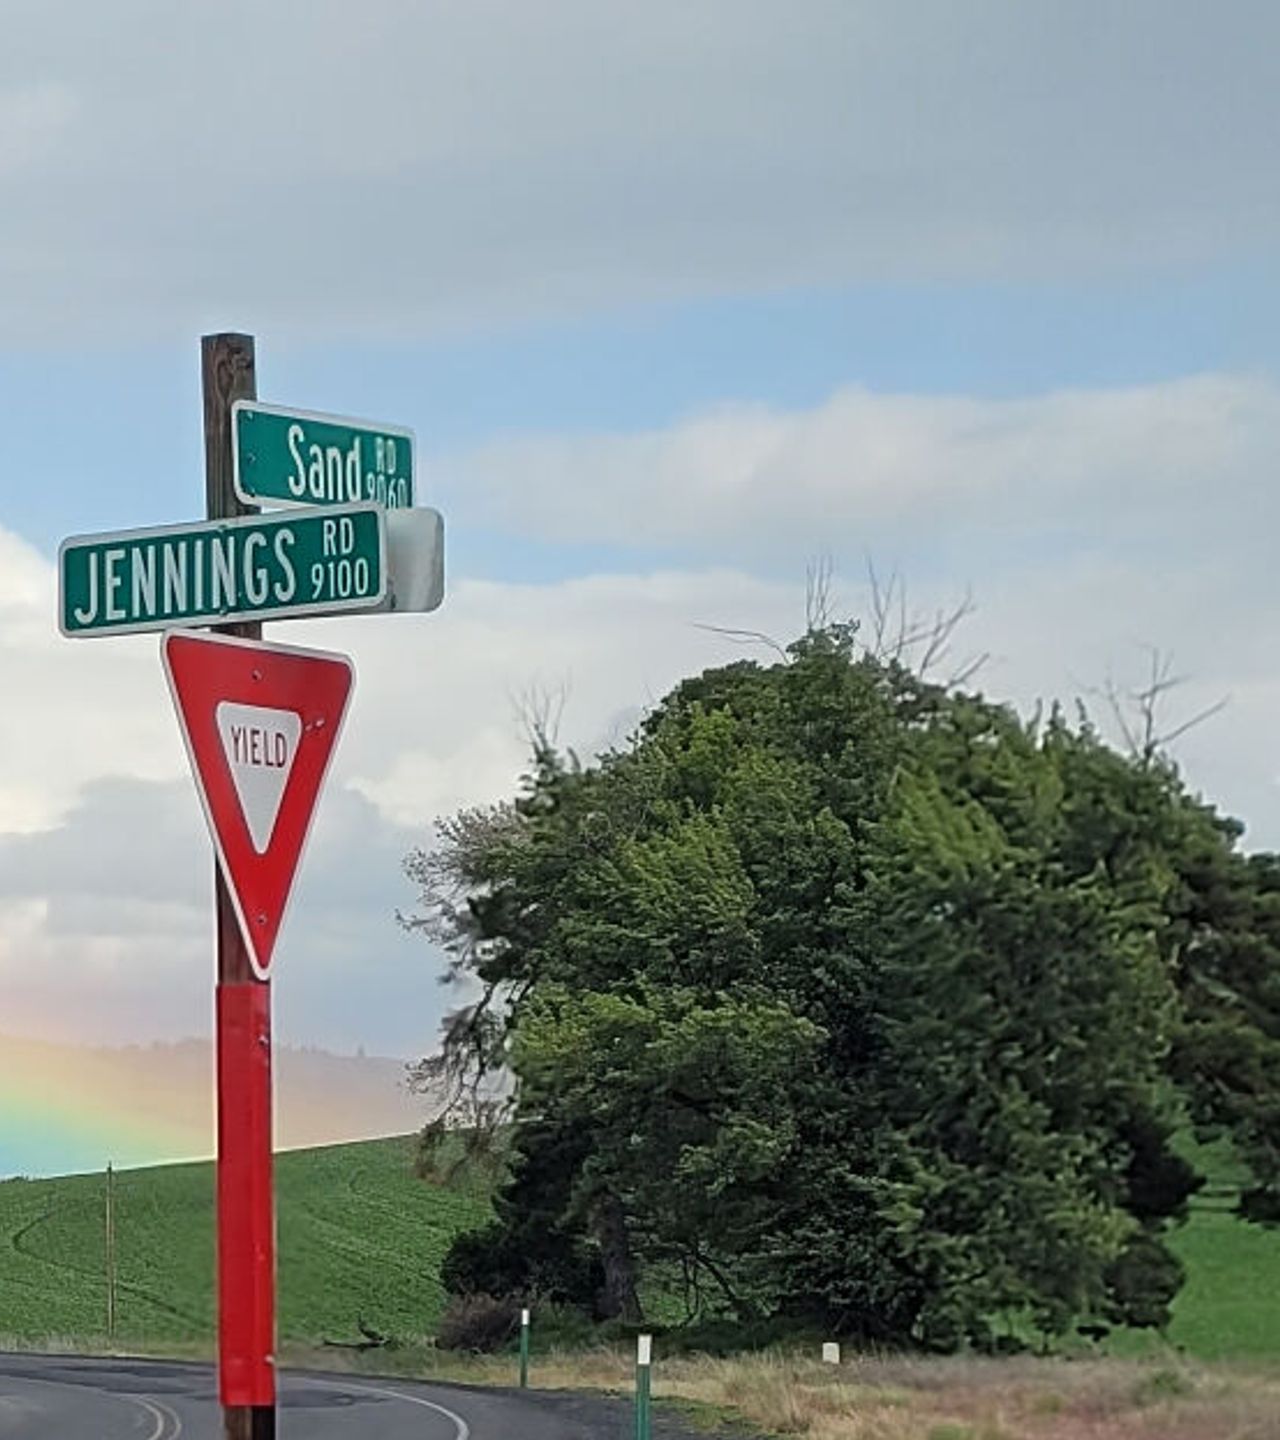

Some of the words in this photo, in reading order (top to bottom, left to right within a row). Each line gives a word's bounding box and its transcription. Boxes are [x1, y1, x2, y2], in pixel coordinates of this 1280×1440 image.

[288, 424, 362, 502] Sand
[374, 436, 397, 475] RD
[74, 528, 297, 625] JENNINGS
[323, 517, 354, 557] RD
[311, 557, 369, 600] 9100
[231, 725, 288, 768] YIELD
